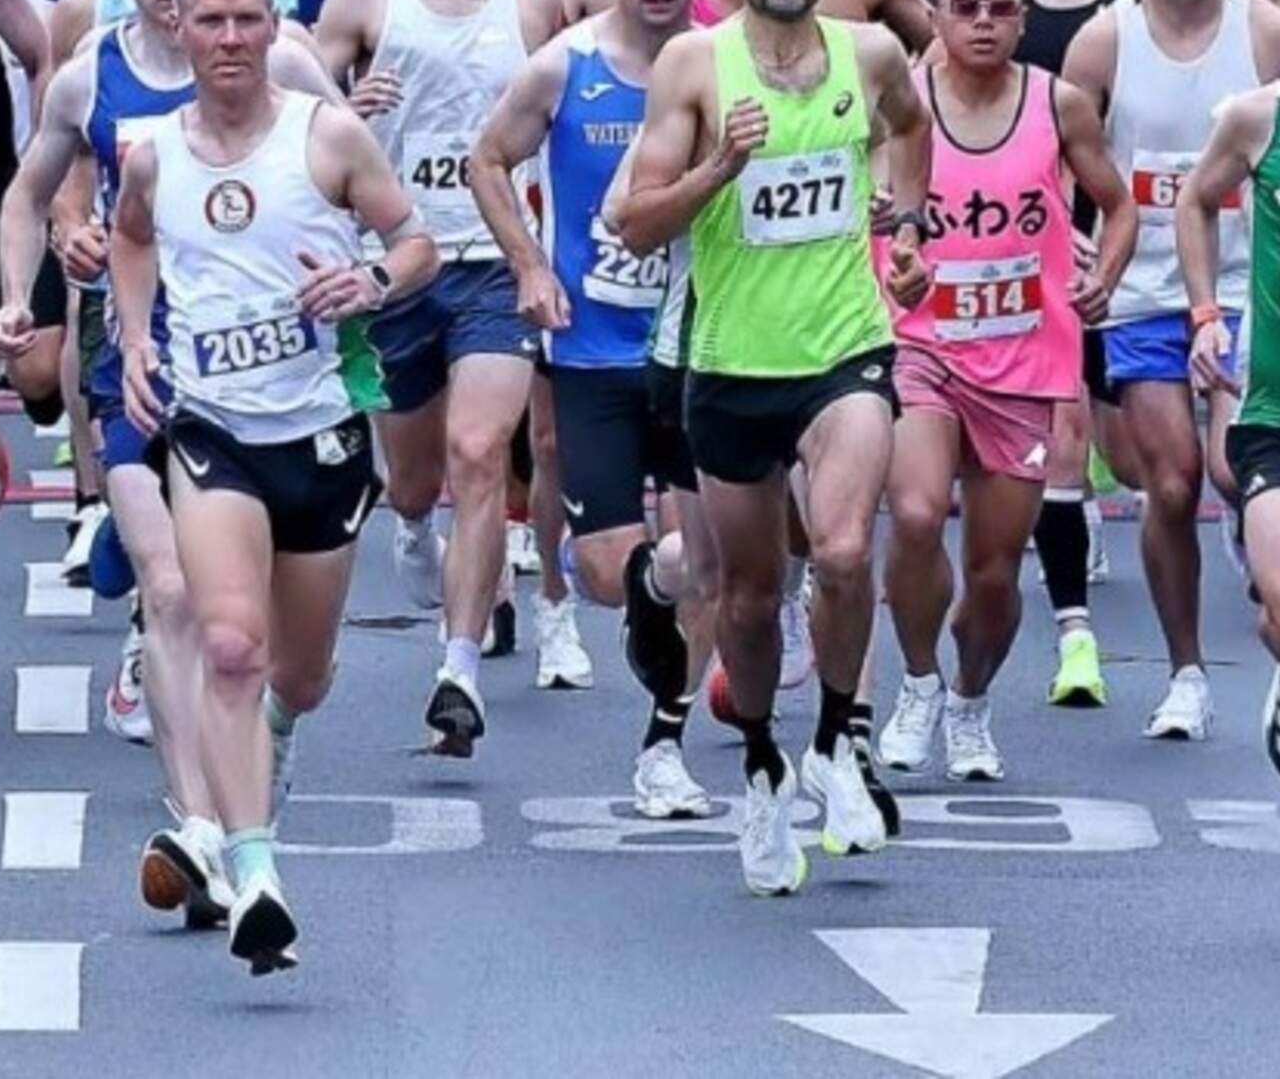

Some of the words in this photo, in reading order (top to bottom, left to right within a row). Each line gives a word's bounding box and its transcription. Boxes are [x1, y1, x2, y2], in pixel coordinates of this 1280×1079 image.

[751, 176, 845, 221] 4277
[954, 278, 1025, 319] 514
[202, 315, 307, 373] 2035
